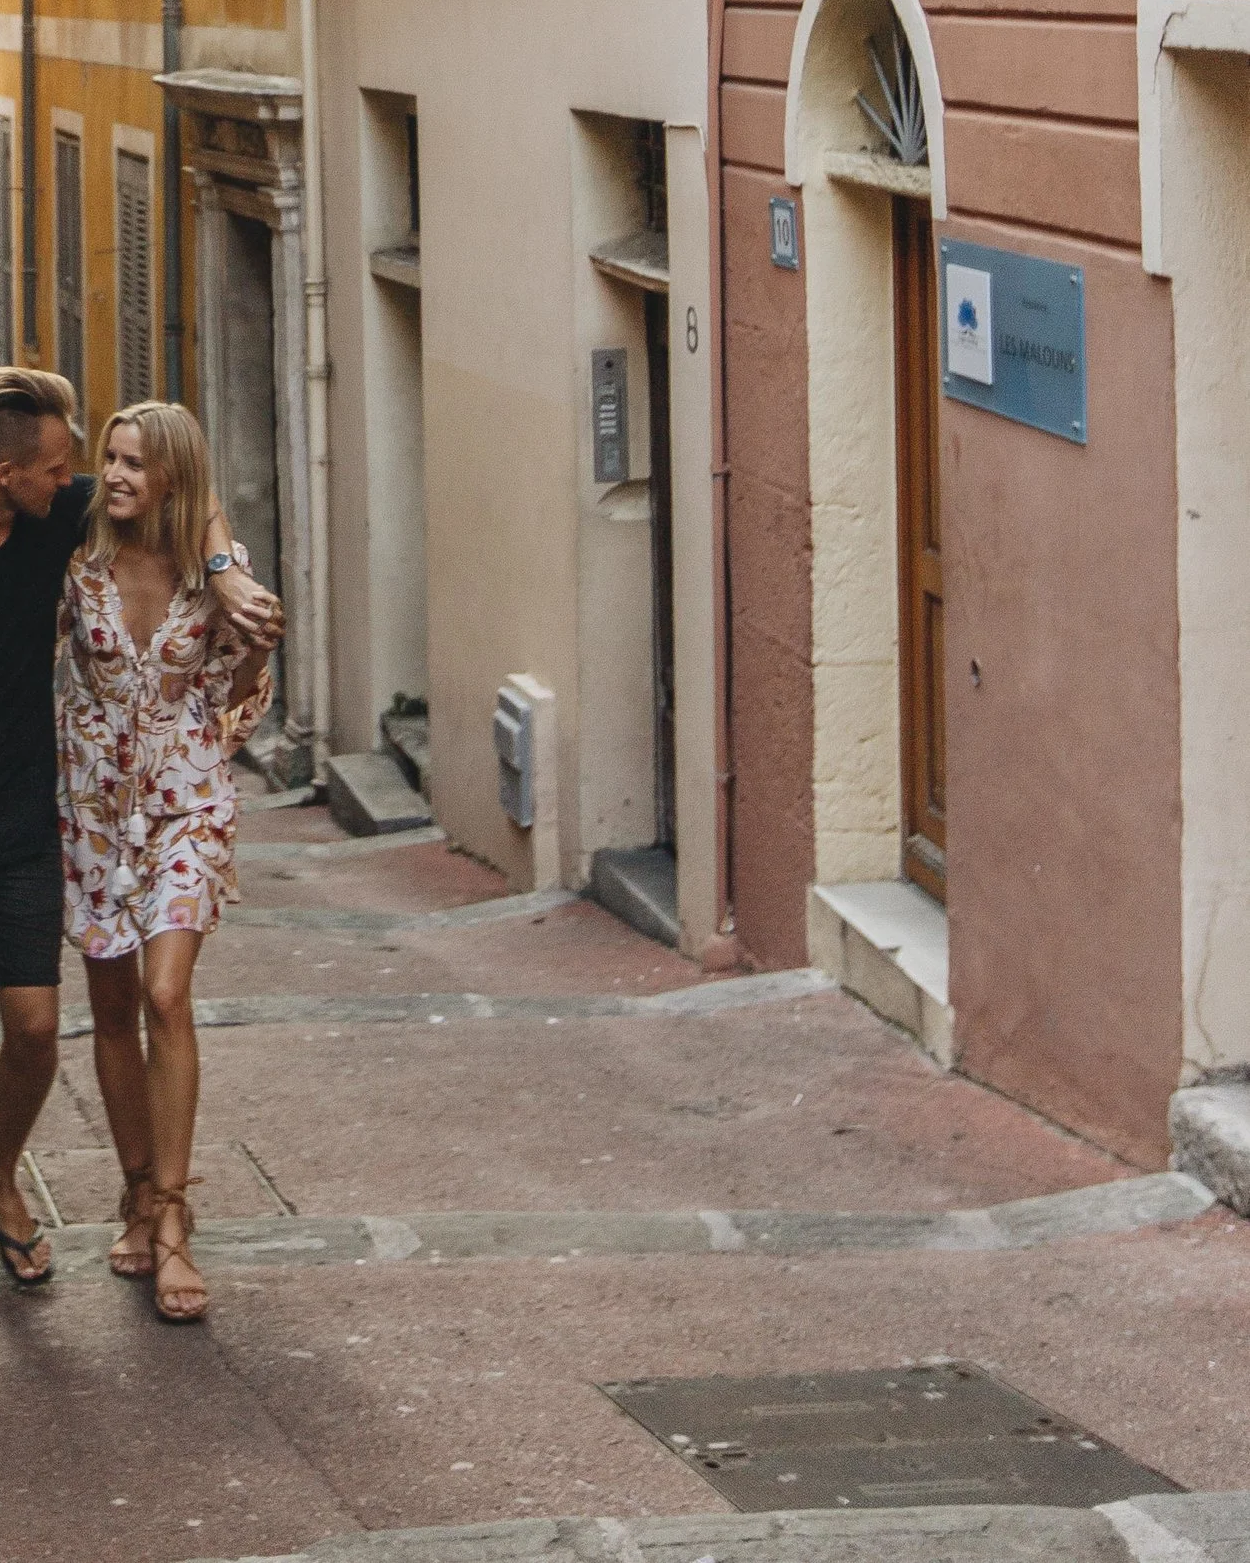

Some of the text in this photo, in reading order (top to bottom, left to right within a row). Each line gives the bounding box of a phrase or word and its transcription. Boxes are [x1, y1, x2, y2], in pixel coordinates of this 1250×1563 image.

[776, 218, 790, 247] 10
[685, 305, 699, 354] 8
[999, 333, 1017, 358] LES
